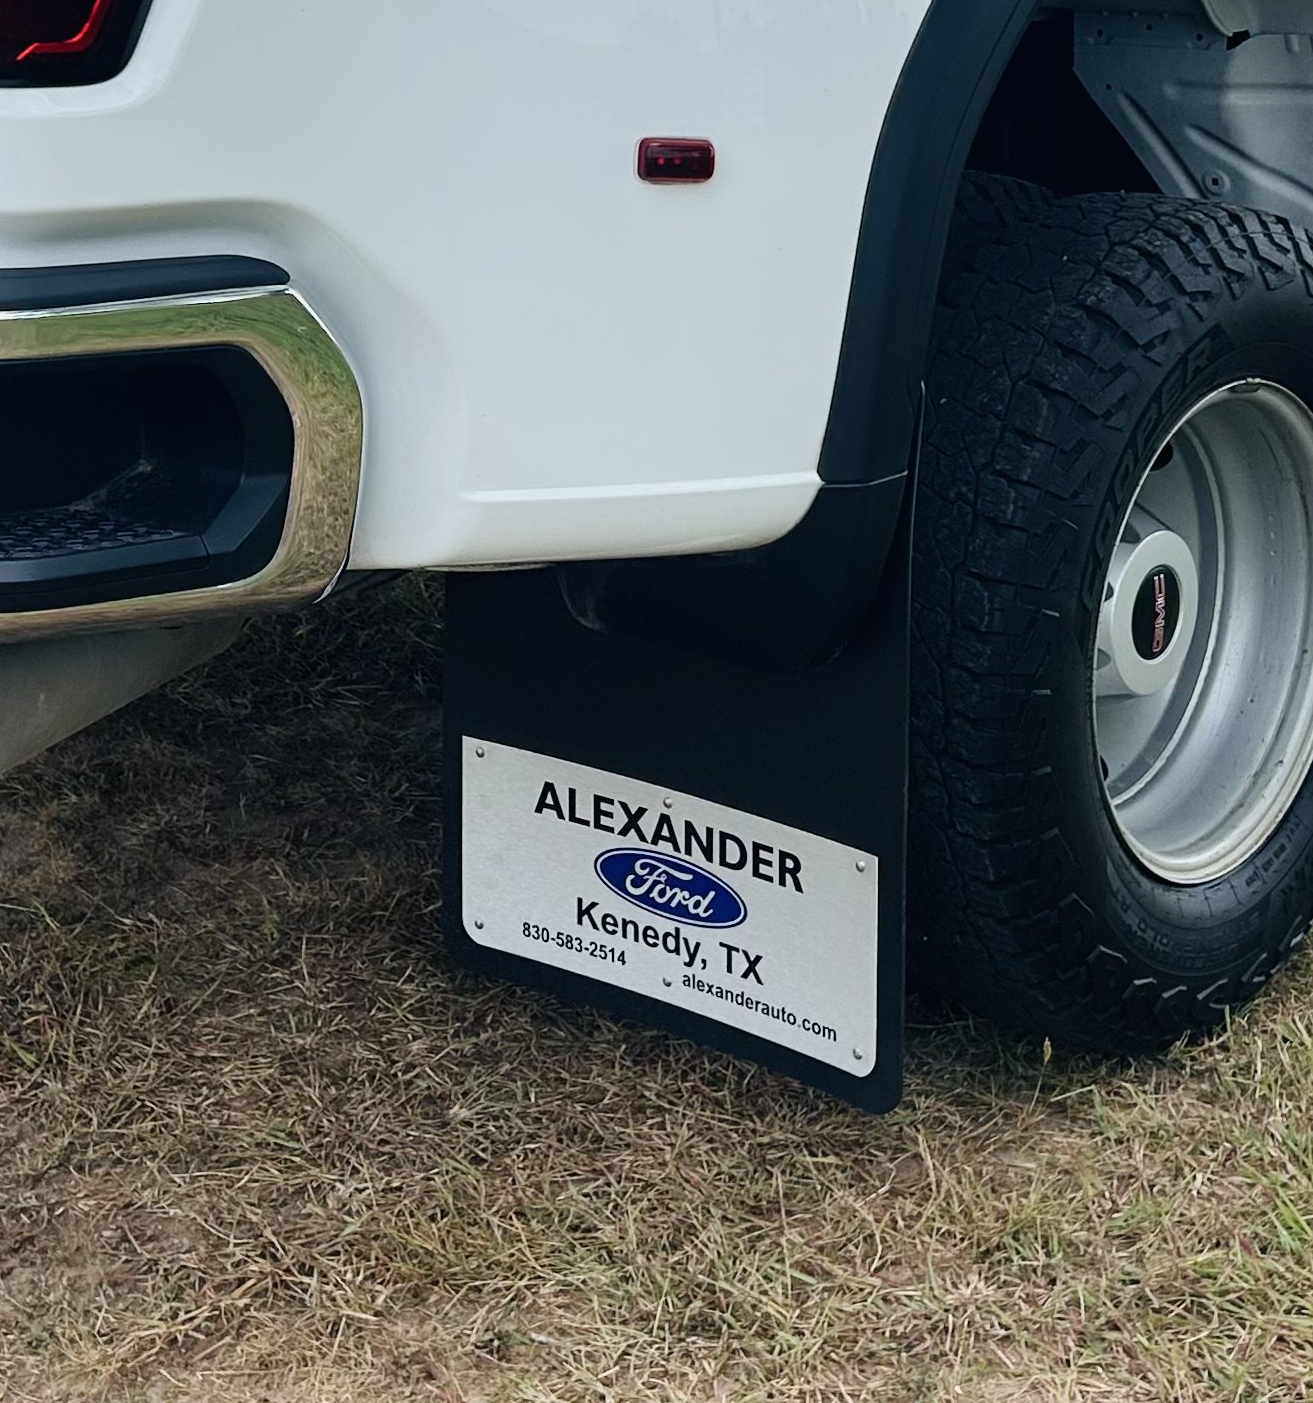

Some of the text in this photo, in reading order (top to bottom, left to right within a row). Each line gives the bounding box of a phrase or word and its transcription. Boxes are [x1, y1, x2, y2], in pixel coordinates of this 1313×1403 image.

[1151, 573, 1166, 653] GMC
[534, 780, 805, 894] ALEXANDER
[624, 857, 715, 921] Ford
[521, 921, 628, 967] 830-583-2514
[575, 896, 765, 986] Kenedy, TX
[681, 972, 838, 1043] alexanderauto.com
